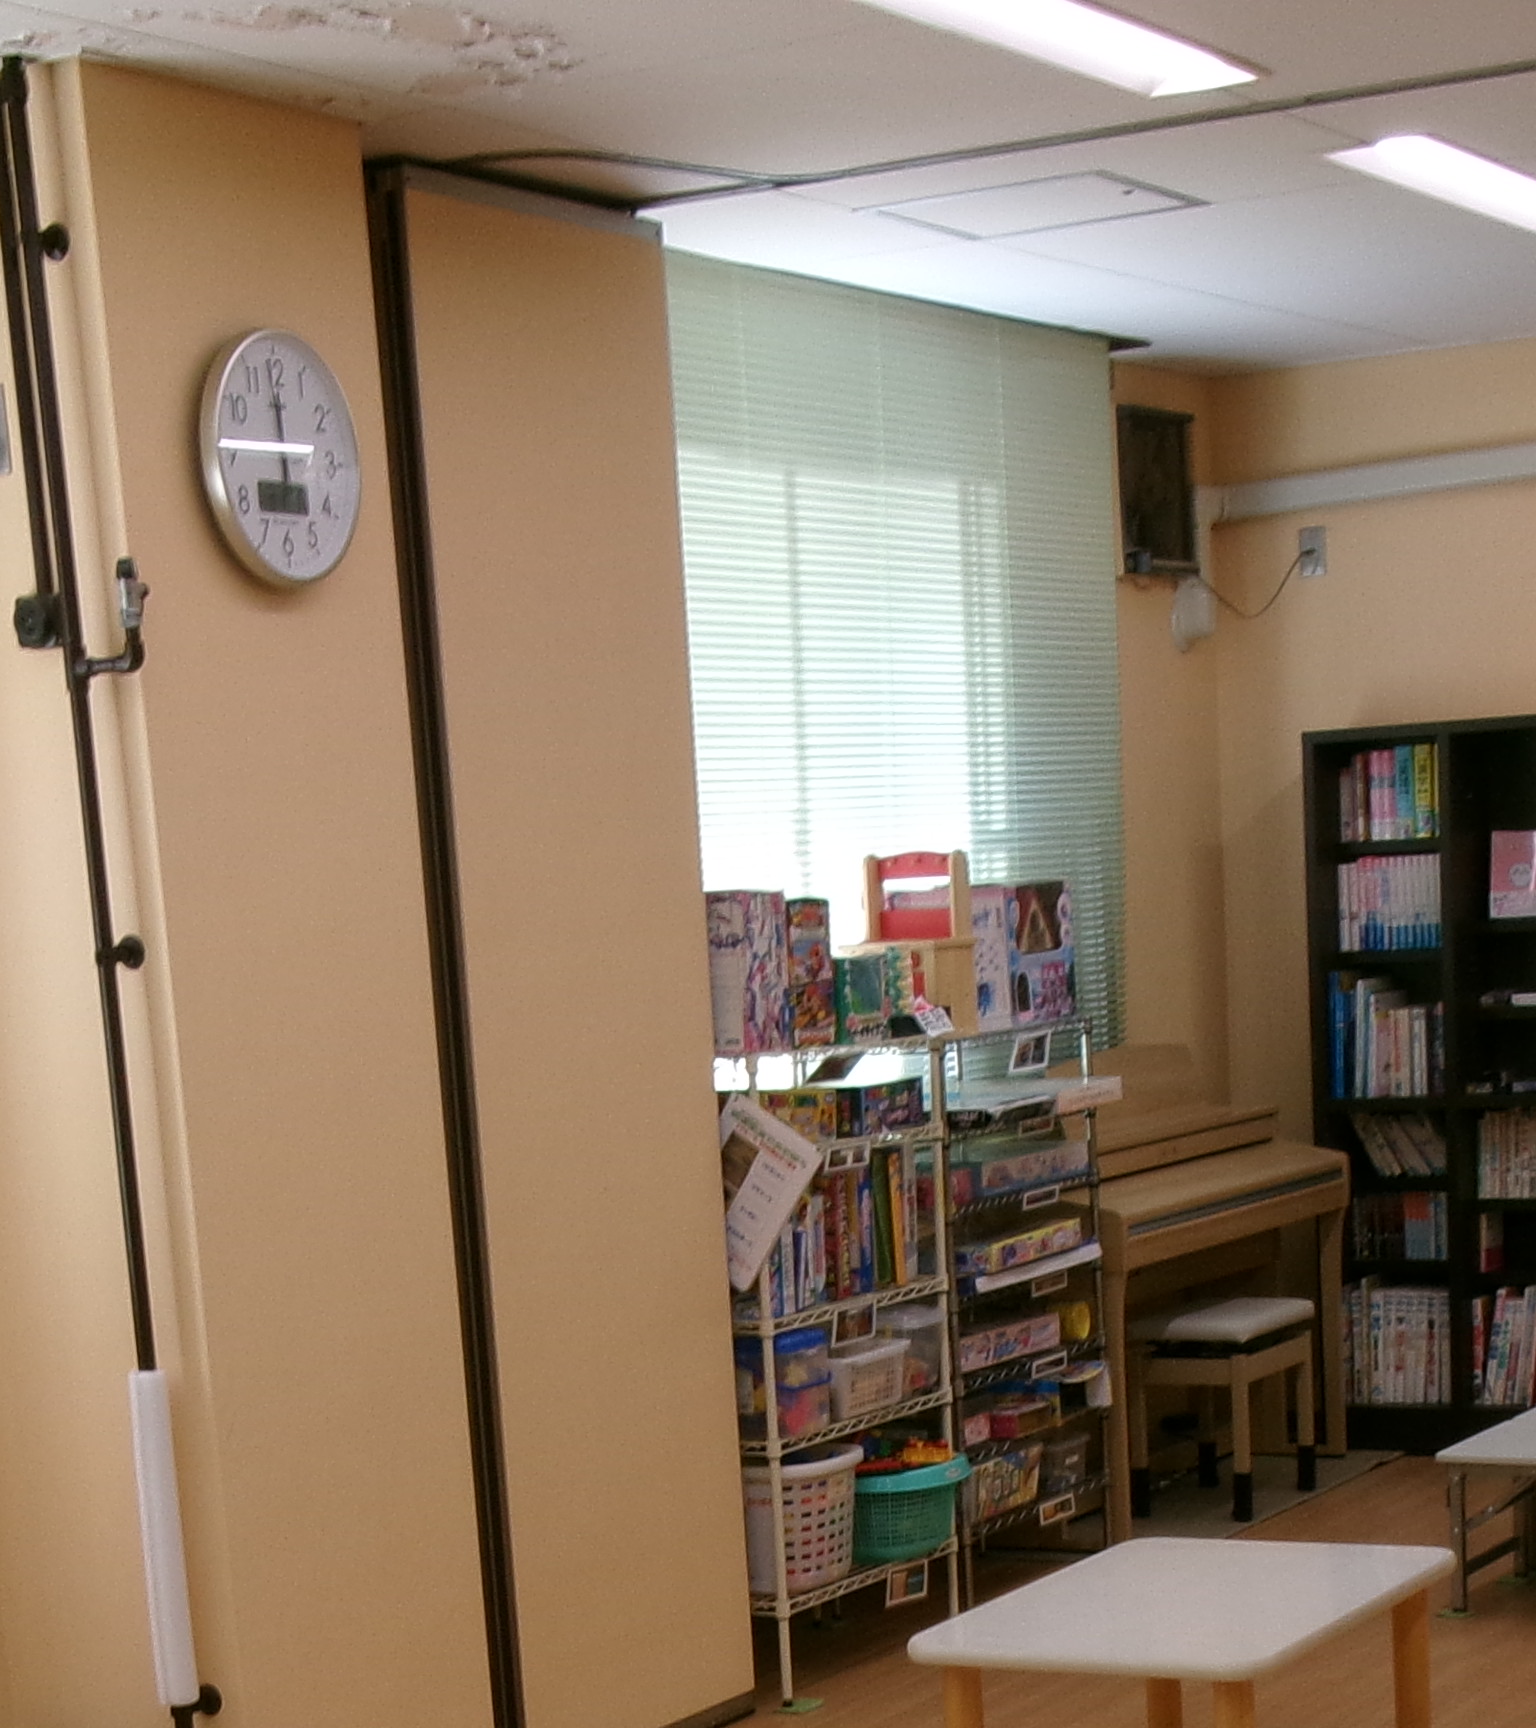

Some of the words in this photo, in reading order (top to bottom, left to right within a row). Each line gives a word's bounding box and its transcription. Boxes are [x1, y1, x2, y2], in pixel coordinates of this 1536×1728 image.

[246, 366, 260, 394] 11
[228, 392, 248, 424] 10
[314, 403, 327, 432] 2
[325, 451, 337, 480] 3
[238, 484, 250, 515] 8
[322, 491, 332, 517] 4
[260, 518, 270, 544] 7
[283, 530, 295, 557] 6
[308, 521, 319, 548] 5
